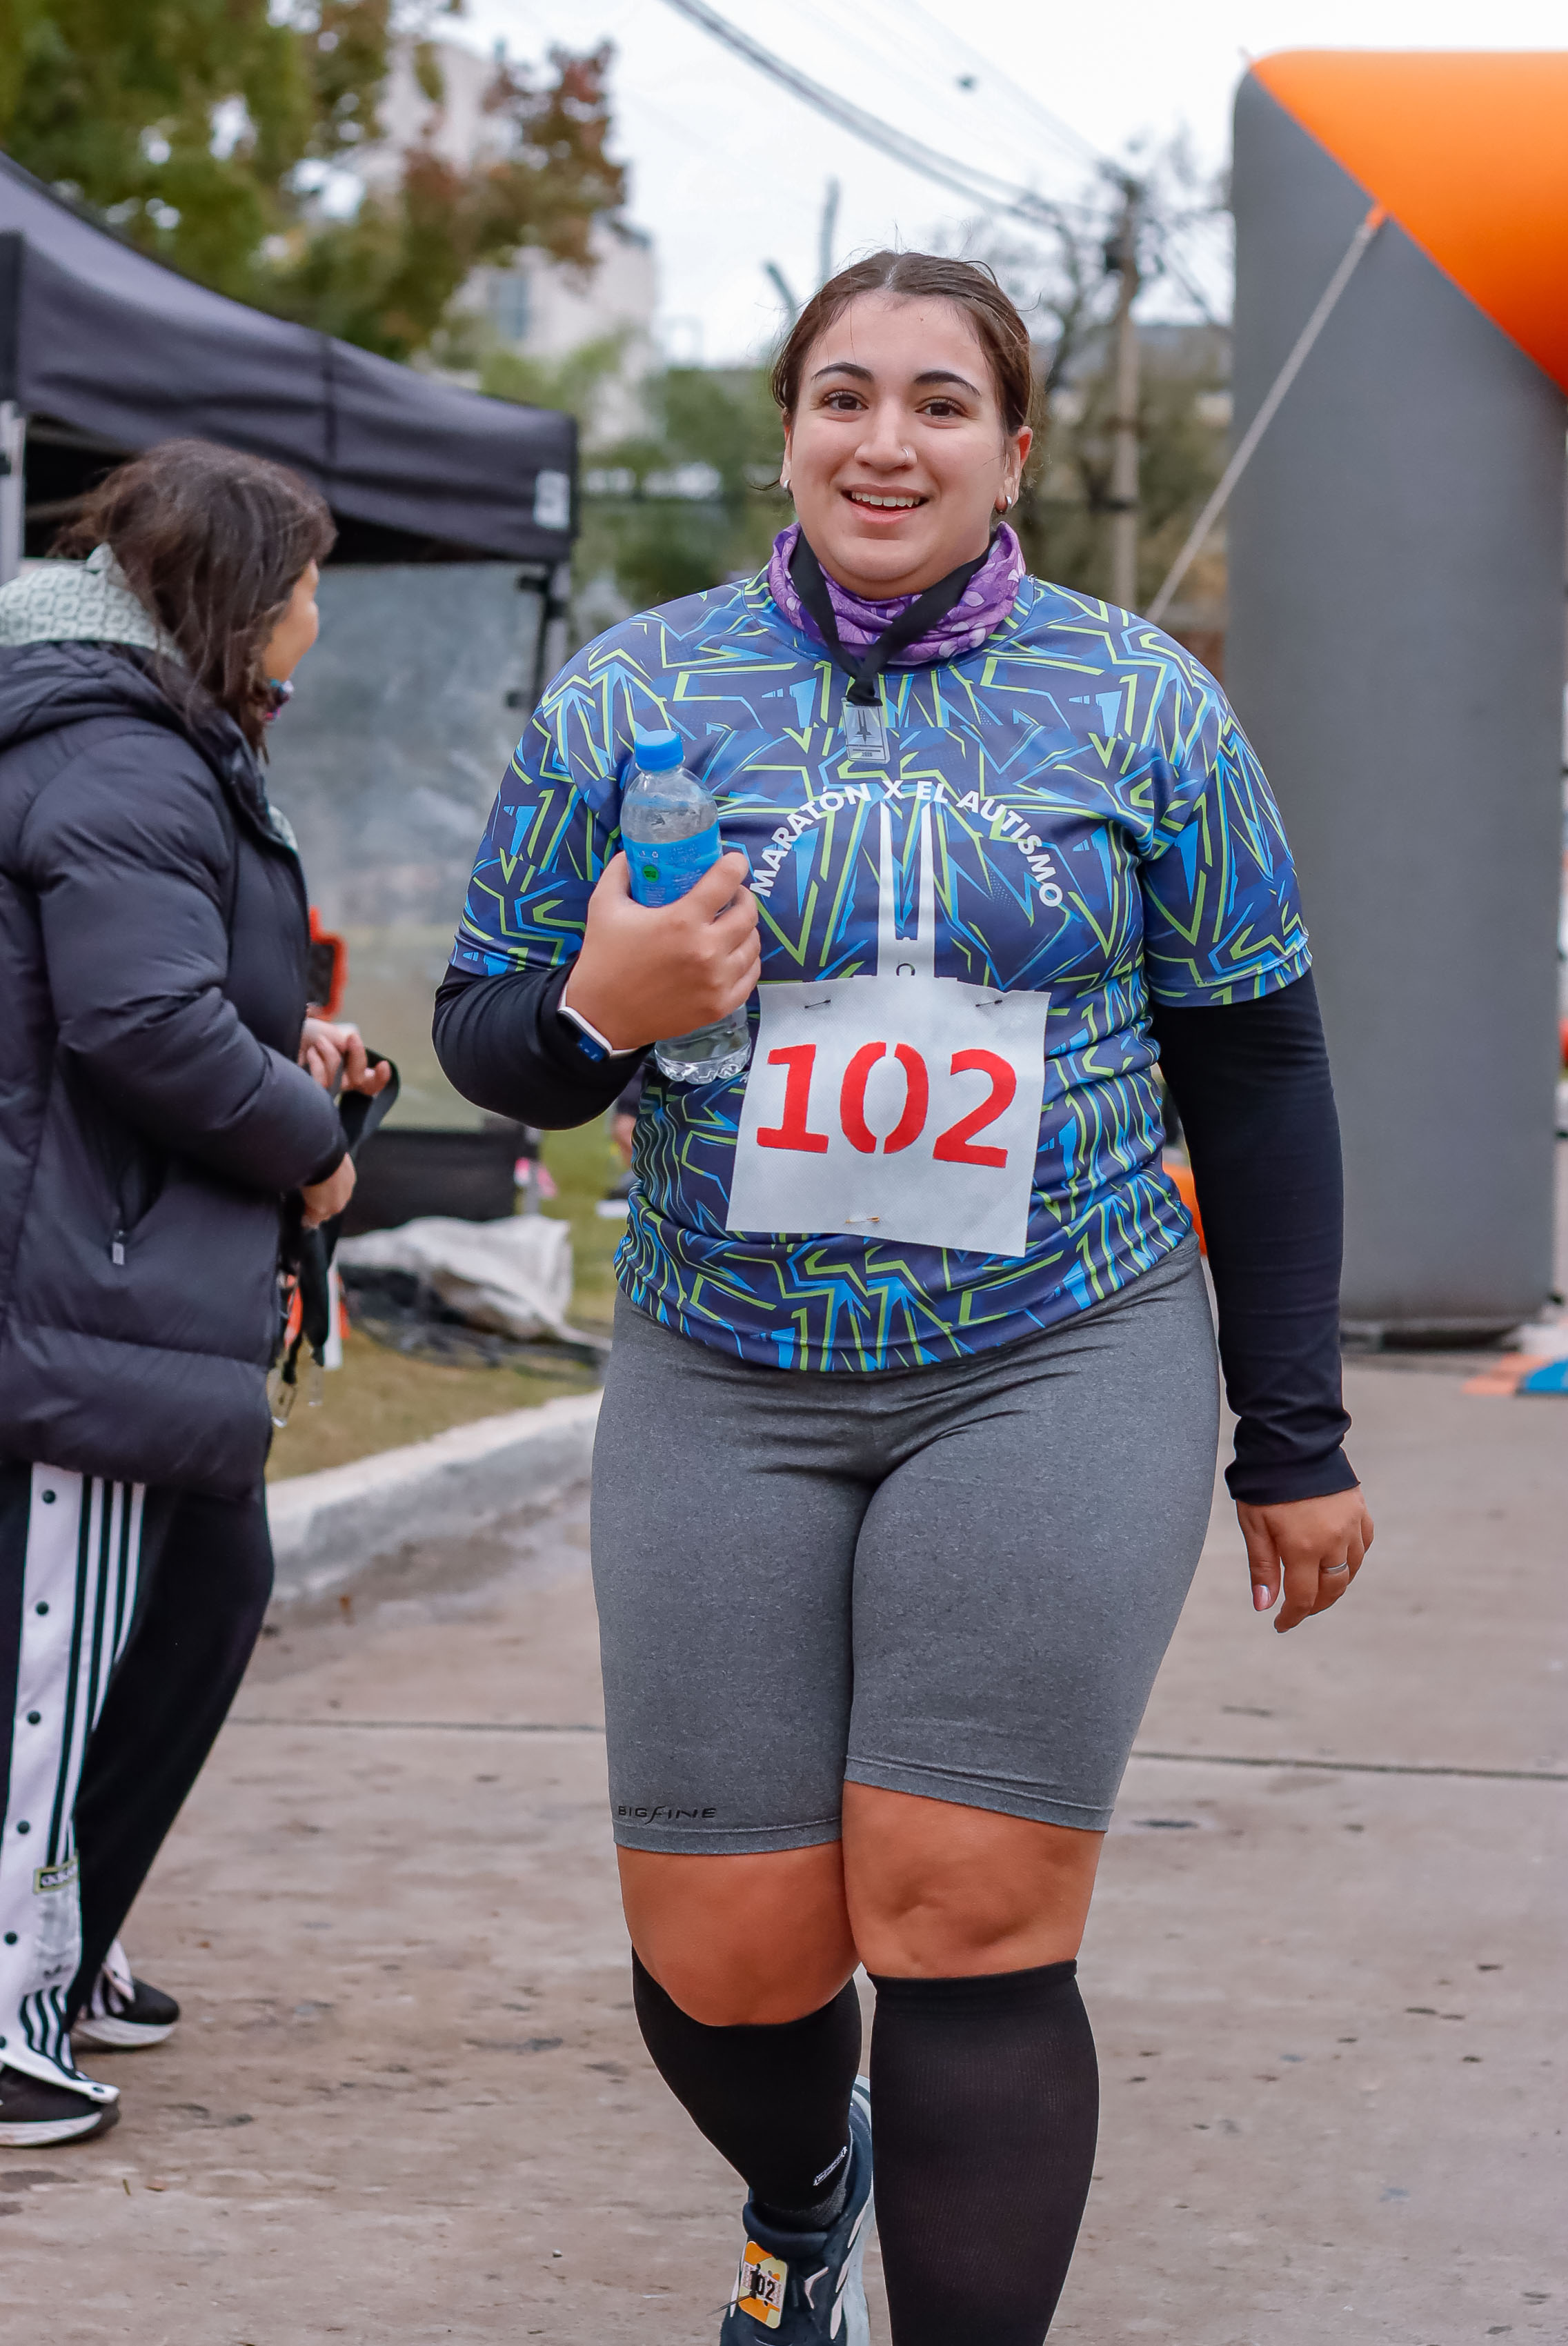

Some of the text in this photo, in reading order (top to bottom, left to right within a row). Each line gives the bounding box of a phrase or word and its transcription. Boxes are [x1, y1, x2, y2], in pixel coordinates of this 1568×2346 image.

[749, 782, 872, 897] MARATÓN
[882, 779, 906, 799] X
[916, 780, 949, 804] EL
[955, 790, 1063, 907] AUTISMO
[756, 1041, 1018, 1169] 102
